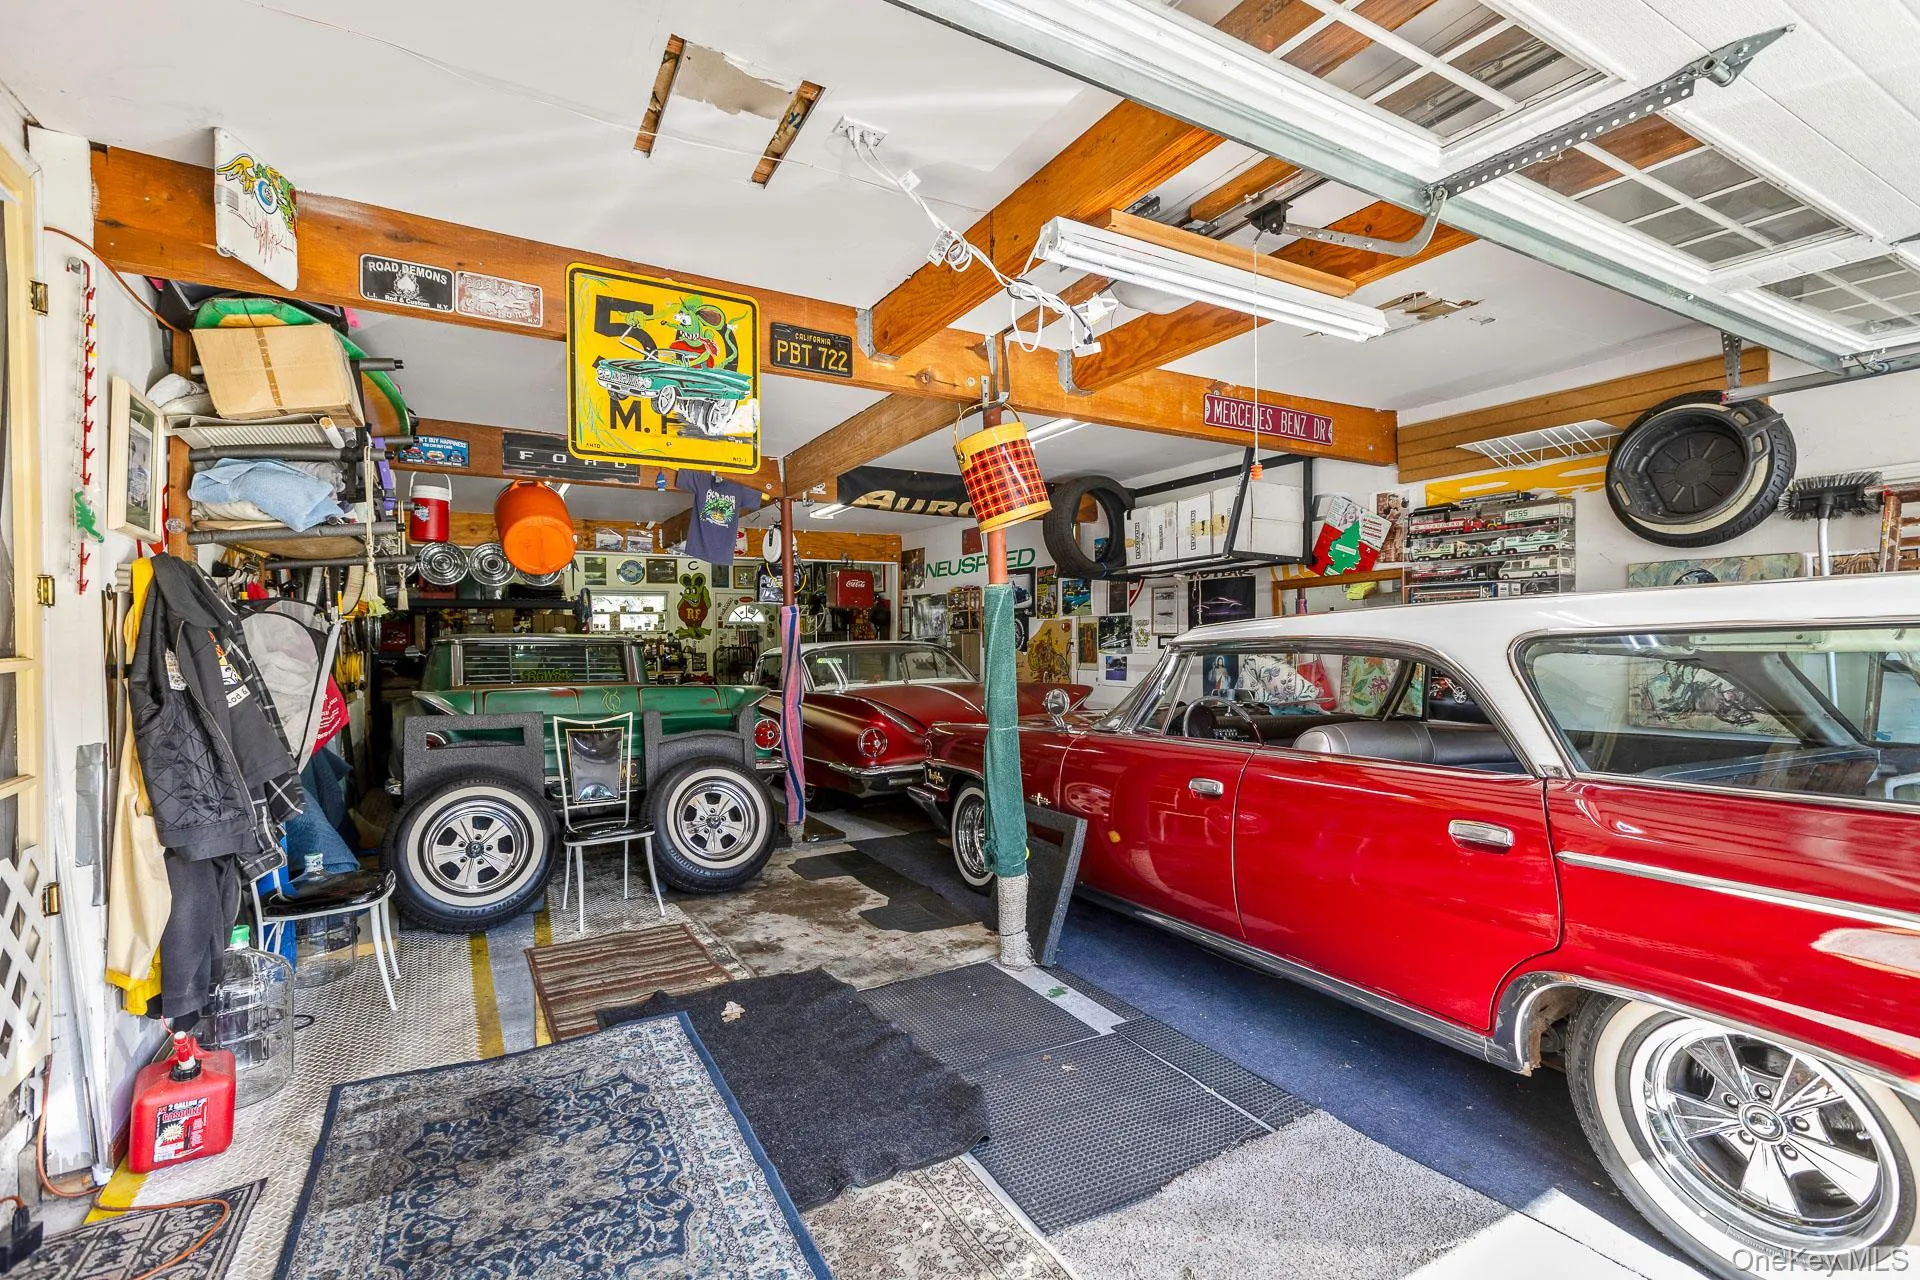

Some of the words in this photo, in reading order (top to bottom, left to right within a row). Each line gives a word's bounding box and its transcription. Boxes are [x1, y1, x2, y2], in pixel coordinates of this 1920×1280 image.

[368, 262, 399, 272] ROAD
[401, 264, 448, 285] DEMONS
[385, 294, 398, 302] Rod
[405, 298, 430, 308] Custom
[795, 333, 831, 346] CALIFORNIA
[777, 340, 813, 366] PBT
[818, 347, 848, 373] 722
[1213, 400, 1273, 431] MERCEDES
[1281, 412, 1307, 437] BENZ
[1313, 418, 1326, 440] DR
[1508, 510, 1528, 518] HESS
[925, 547, 1036, 579] NEUSPED
[162, 1106, 203, 1121] GASOLINE
